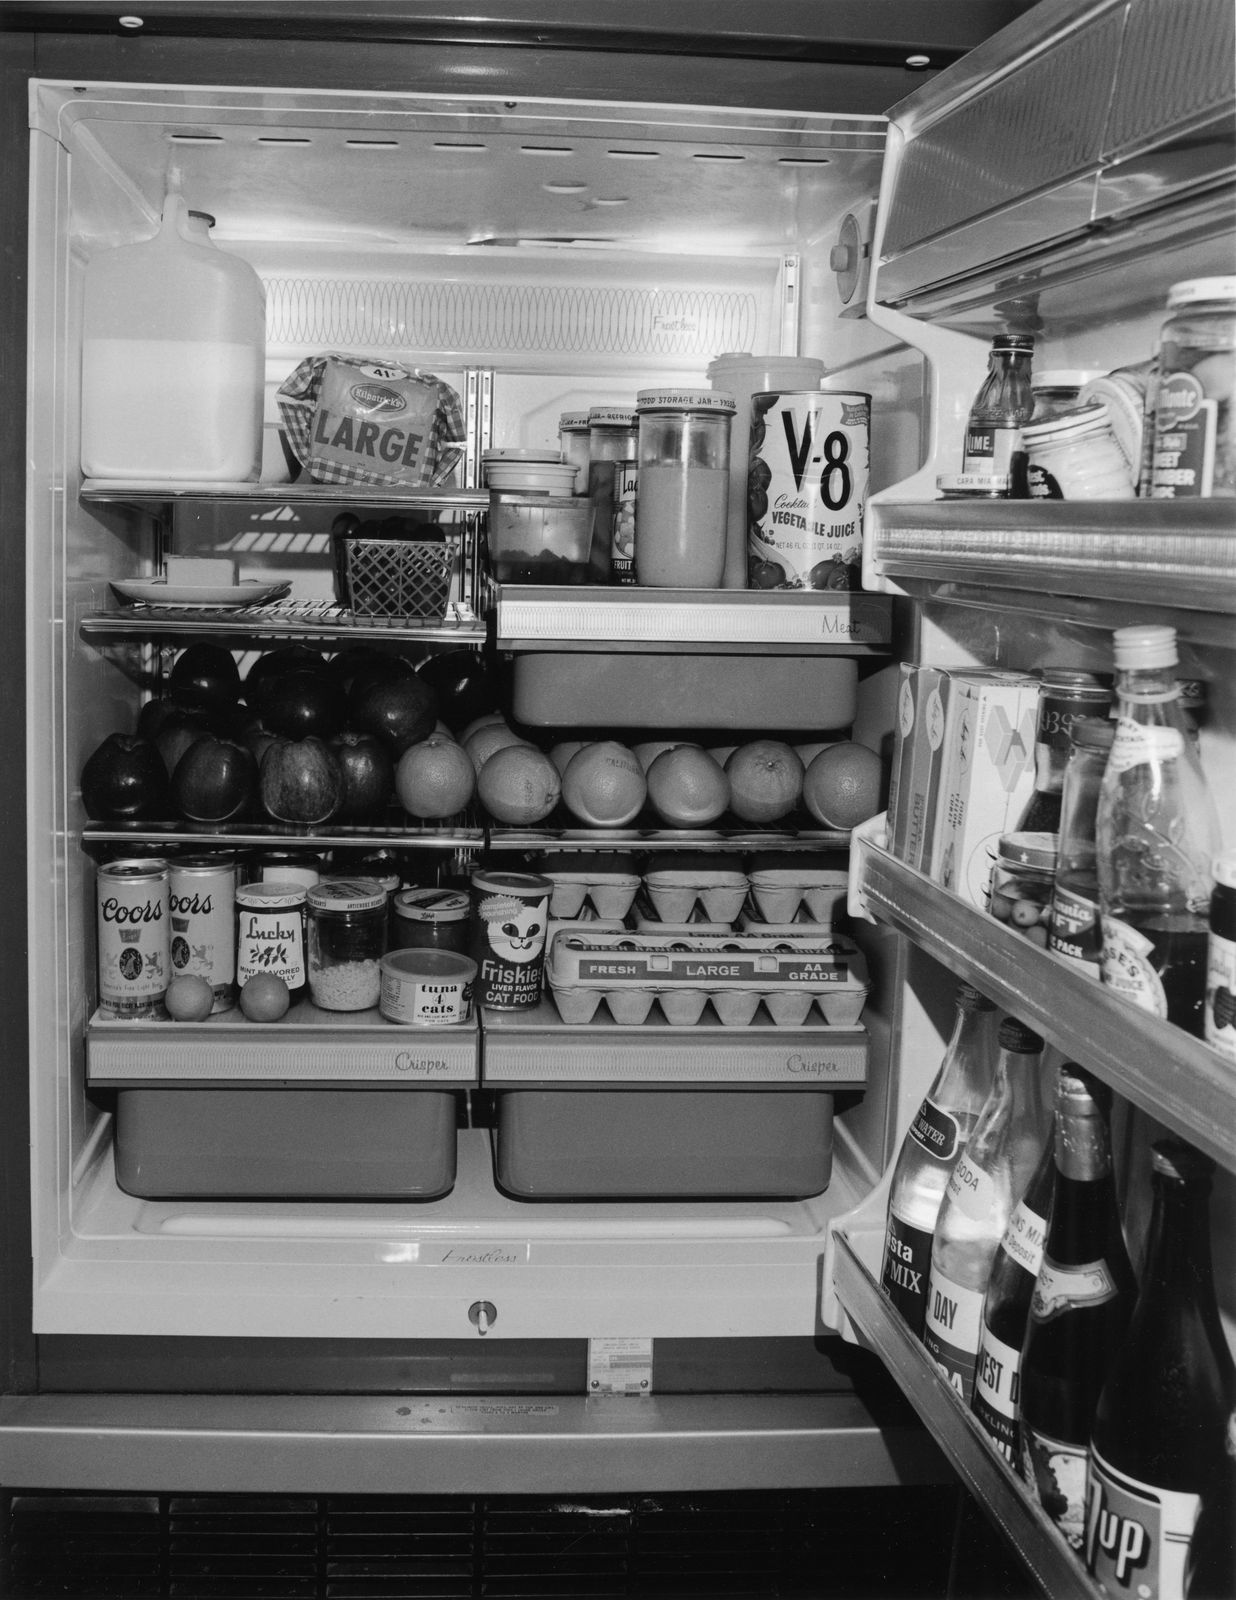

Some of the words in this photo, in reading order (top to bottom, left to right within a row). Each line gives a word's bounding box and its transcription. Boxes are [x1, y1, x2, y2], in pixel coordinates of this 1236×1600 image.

[658, 396, 694, 404] STORAGE
[698, 397, 712, 405] JAR
[314, 410, 423, 468] LARGE
[781, 410, 851, 511] V-8
[774, 493, 818, 509] Cockta
[772, 511, 826, 537] VEGETALE
[826, 521, 856, 538] JUICE
[614, 560, 633, 570] FRUIT
[822, 614, 861, 634] Meat
[908, 792, 921, 865] BUTTER
[101, 897, 163, 924] Coors
[168, 892, 212, 914] oors
[246, 917, 295, 942] Lucky
[1056, 939, 1083, 958] PACK
[240, 966, 256, 975] MINT
[257, 967, 300, 977] AVORED
[589, 965, 637, 975] FRESH
[686, 965, 740, 976] LARGE
[788, 972, 838, 981] GRADE
[804, 963, 822, 972] AA
[421, 984, 457, 993] tuna
[486, 991, 510, 1003] CAT
[513, 992, 539, 1003] FOOD
[491, 983, 513, 991] LIVER
[515, 983, 538, 992] FLAVOR
[421, 1005, 454, 1013] cats
[395, 1052, 449, 1074] Crisper
[787, 1055, 840, 1075] Crisper
[917, 1118, 946, 1146] WATER
[956, 1160, 980, 1191] SODA
[887, 1232, 914, 1263] sta
[890, 1259, 923, 1294] MIX
[933, 1289, 958, 1330] DAY
